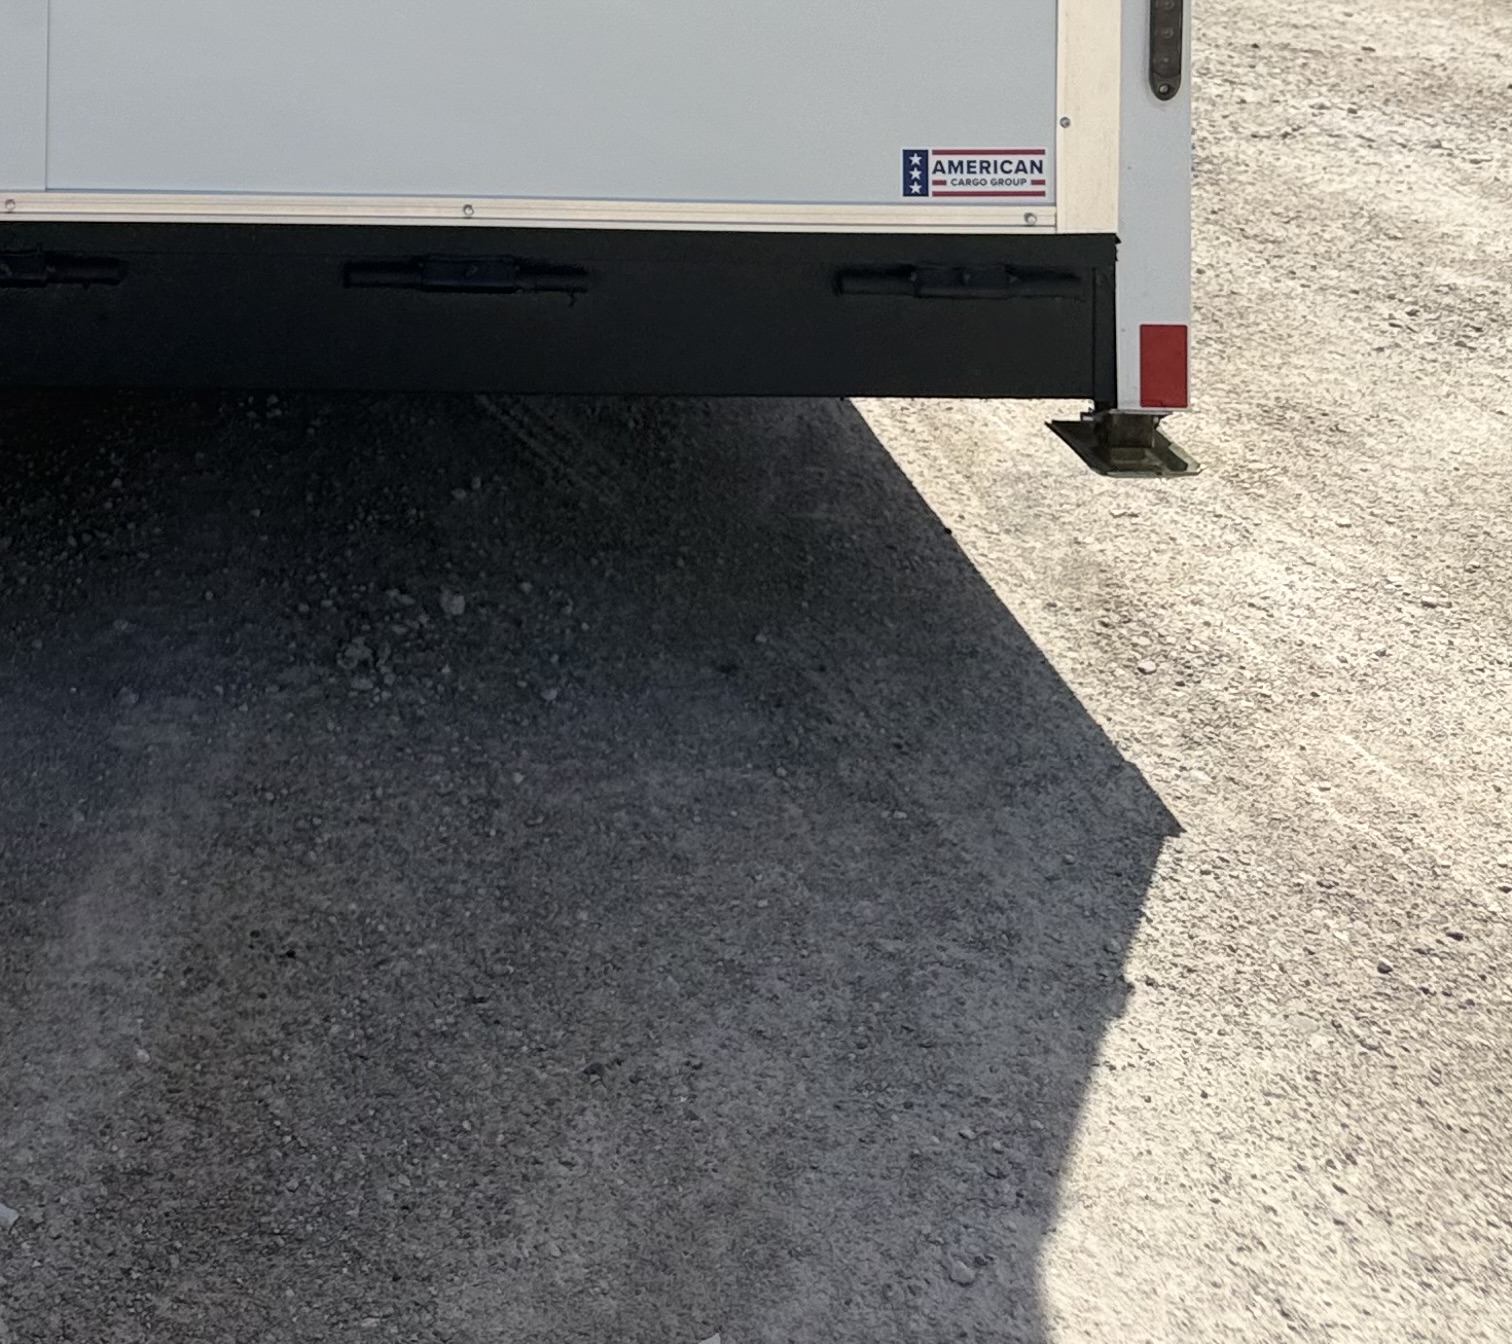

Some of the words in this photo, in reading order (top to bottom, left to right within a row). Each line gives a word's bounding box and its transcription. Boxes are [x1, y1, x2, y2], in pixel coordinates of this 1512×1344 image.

[931, 159, 1044, 175] AMERICAN
[950, 178, 988, 187] CARGO
[990, 178, 1027, 187] GROUP
